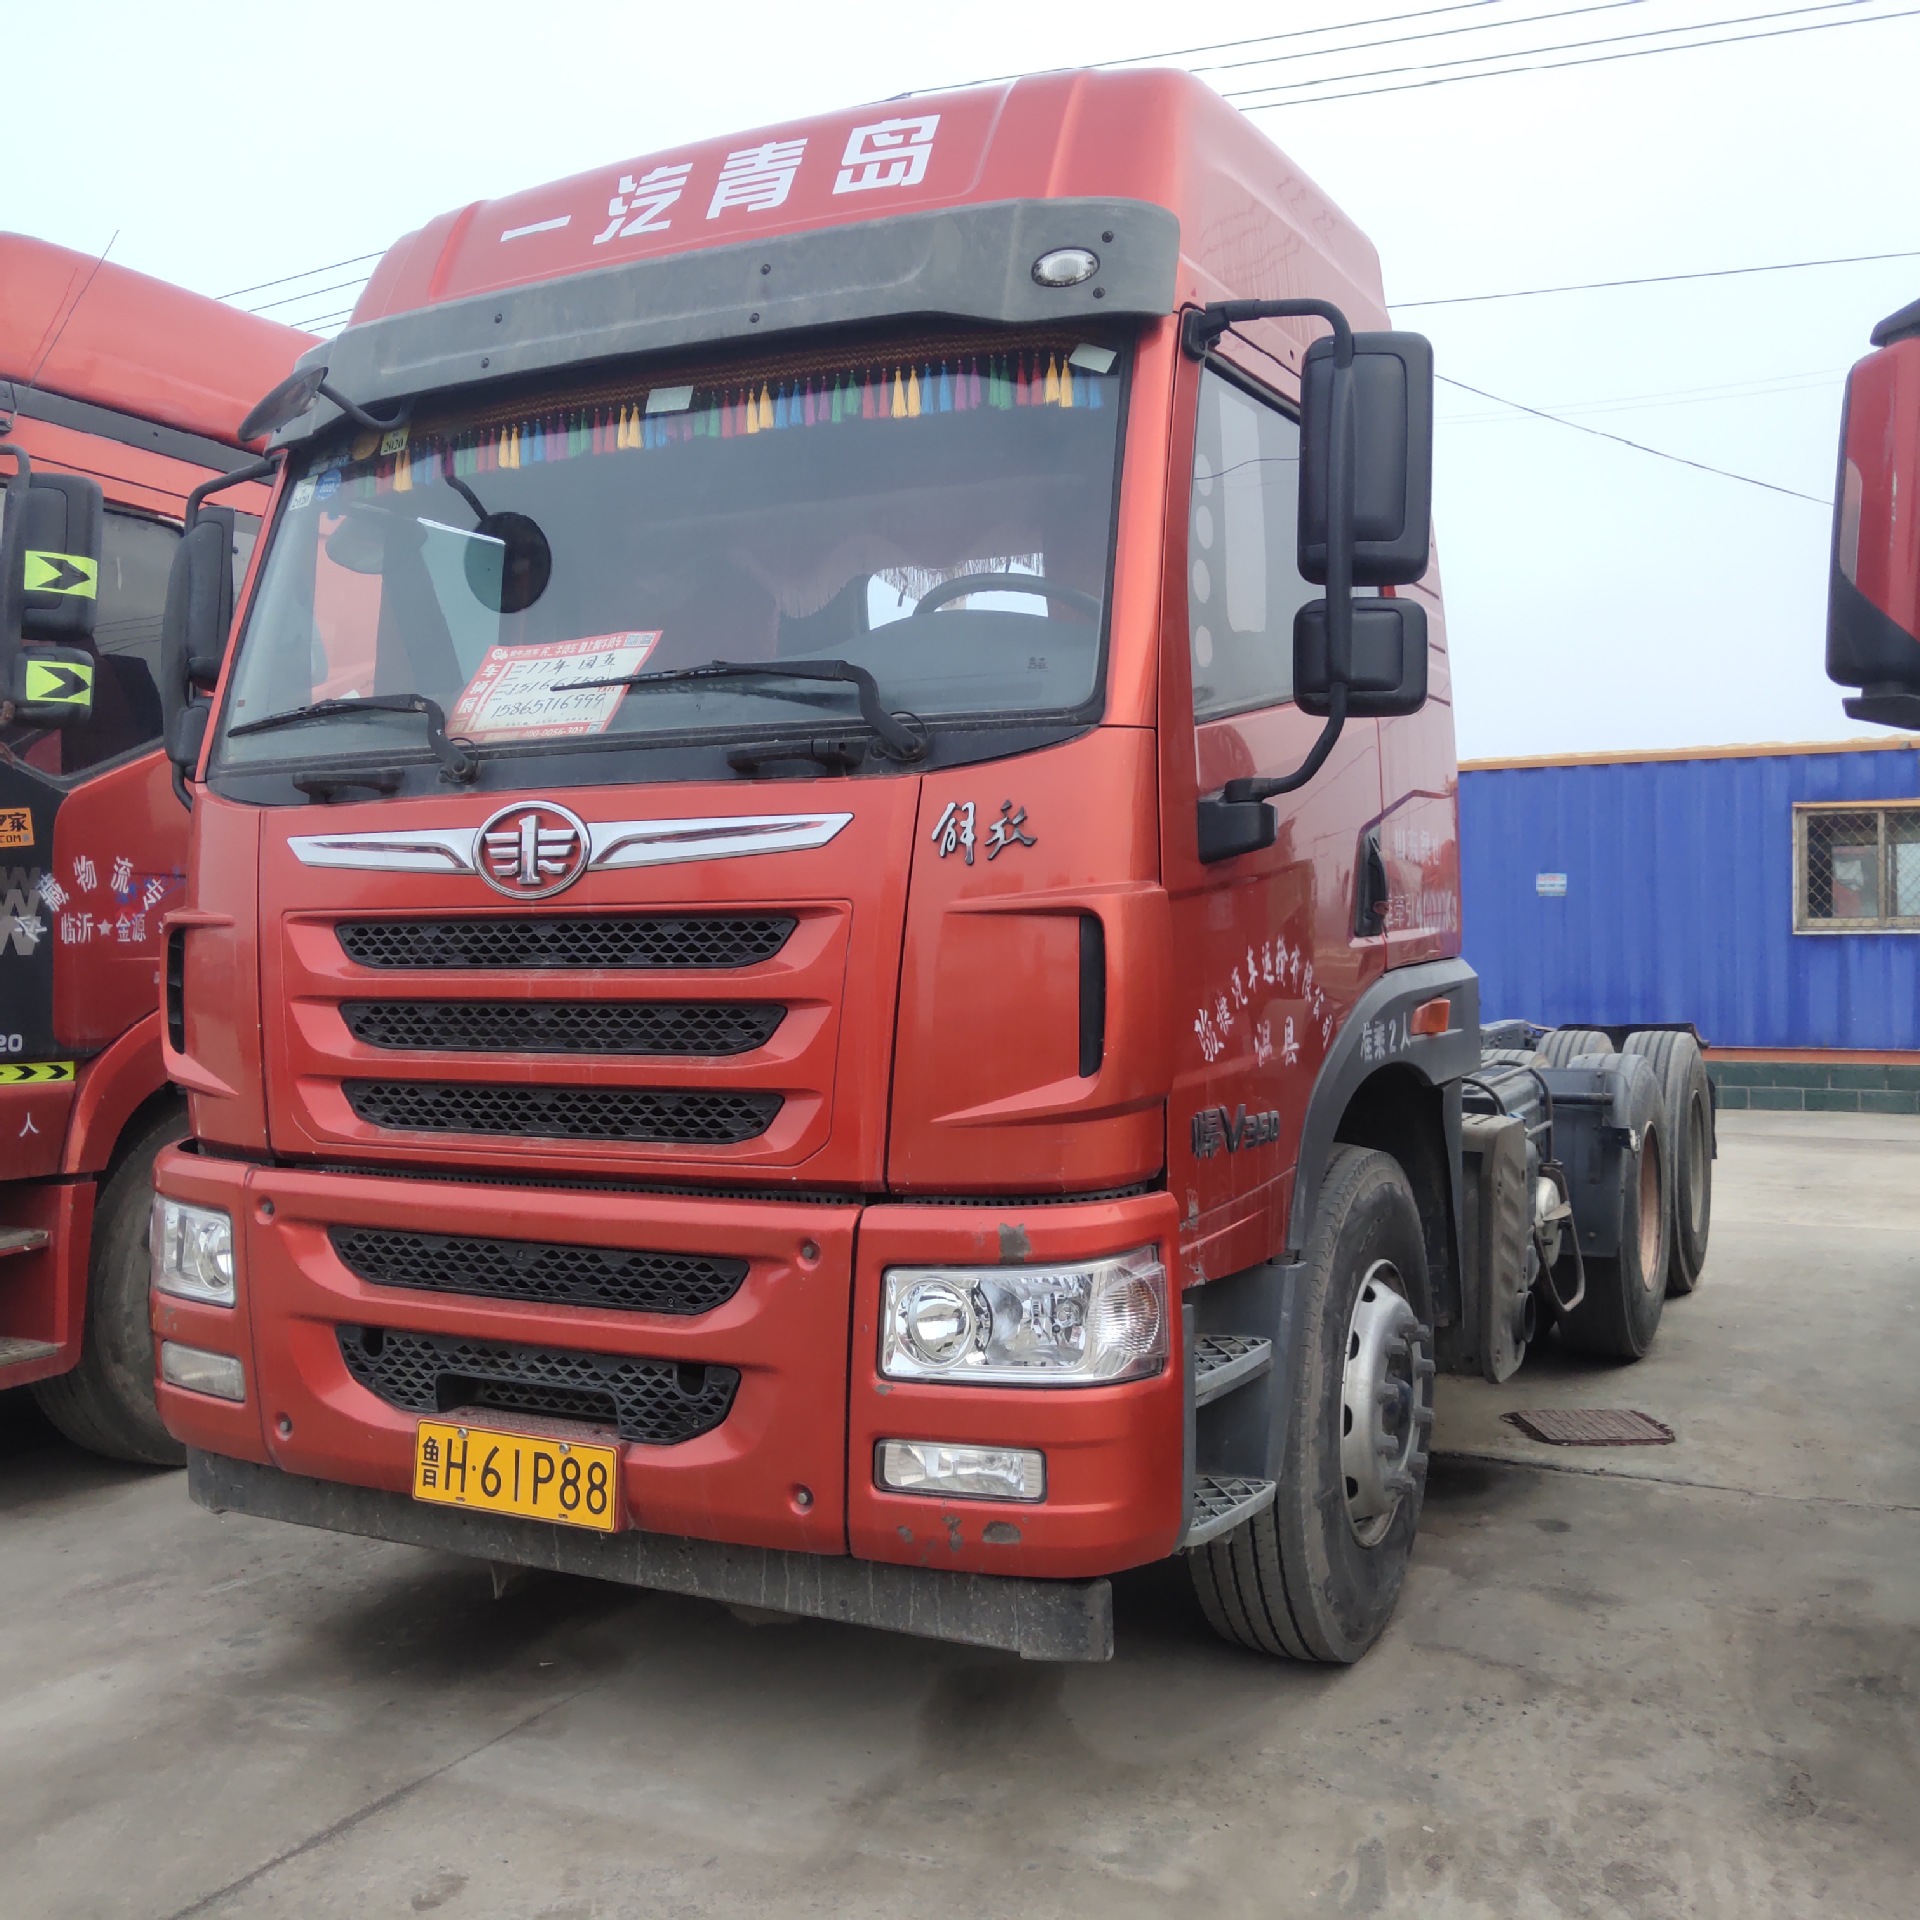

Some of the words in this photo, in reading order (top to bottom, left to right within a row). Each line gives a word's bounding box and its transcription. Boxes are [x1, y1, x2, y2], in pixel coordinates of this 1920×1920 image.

[500, 114, 941, 246] 一汽青岛
[19, 1111, 40, 1138] 人
